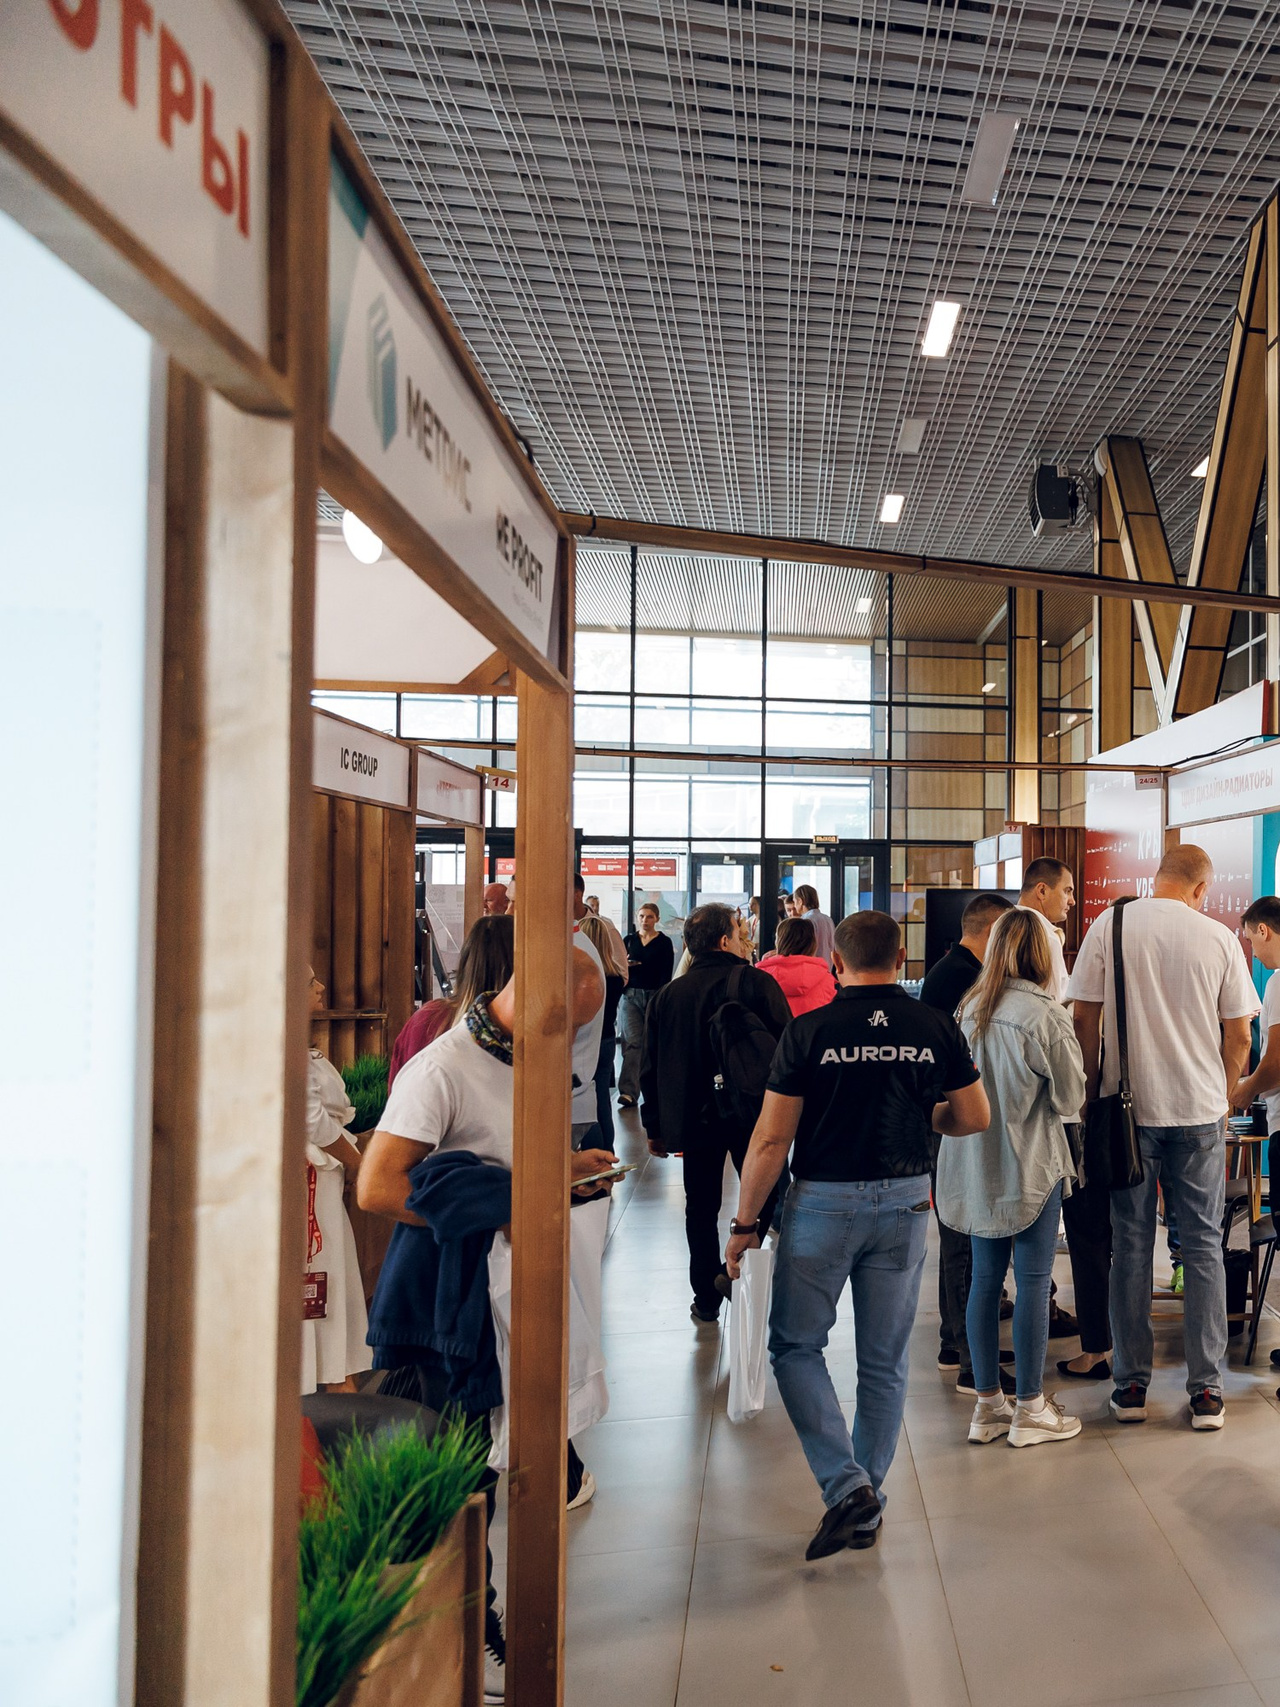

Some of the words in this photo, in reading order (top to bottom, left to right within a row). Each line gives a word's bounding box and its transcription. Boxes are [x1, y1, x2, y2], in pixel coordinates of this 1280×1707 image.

[511, 524, 543, 603] PROFIT
[340, 747, 350, 770] IC
[351, 750, 379, 778] GROUP
[492, 777, 509, 789] 14
[1139, 777, 1158, 785] 24/25
[820, 1046, 935, 1065] AURORA
